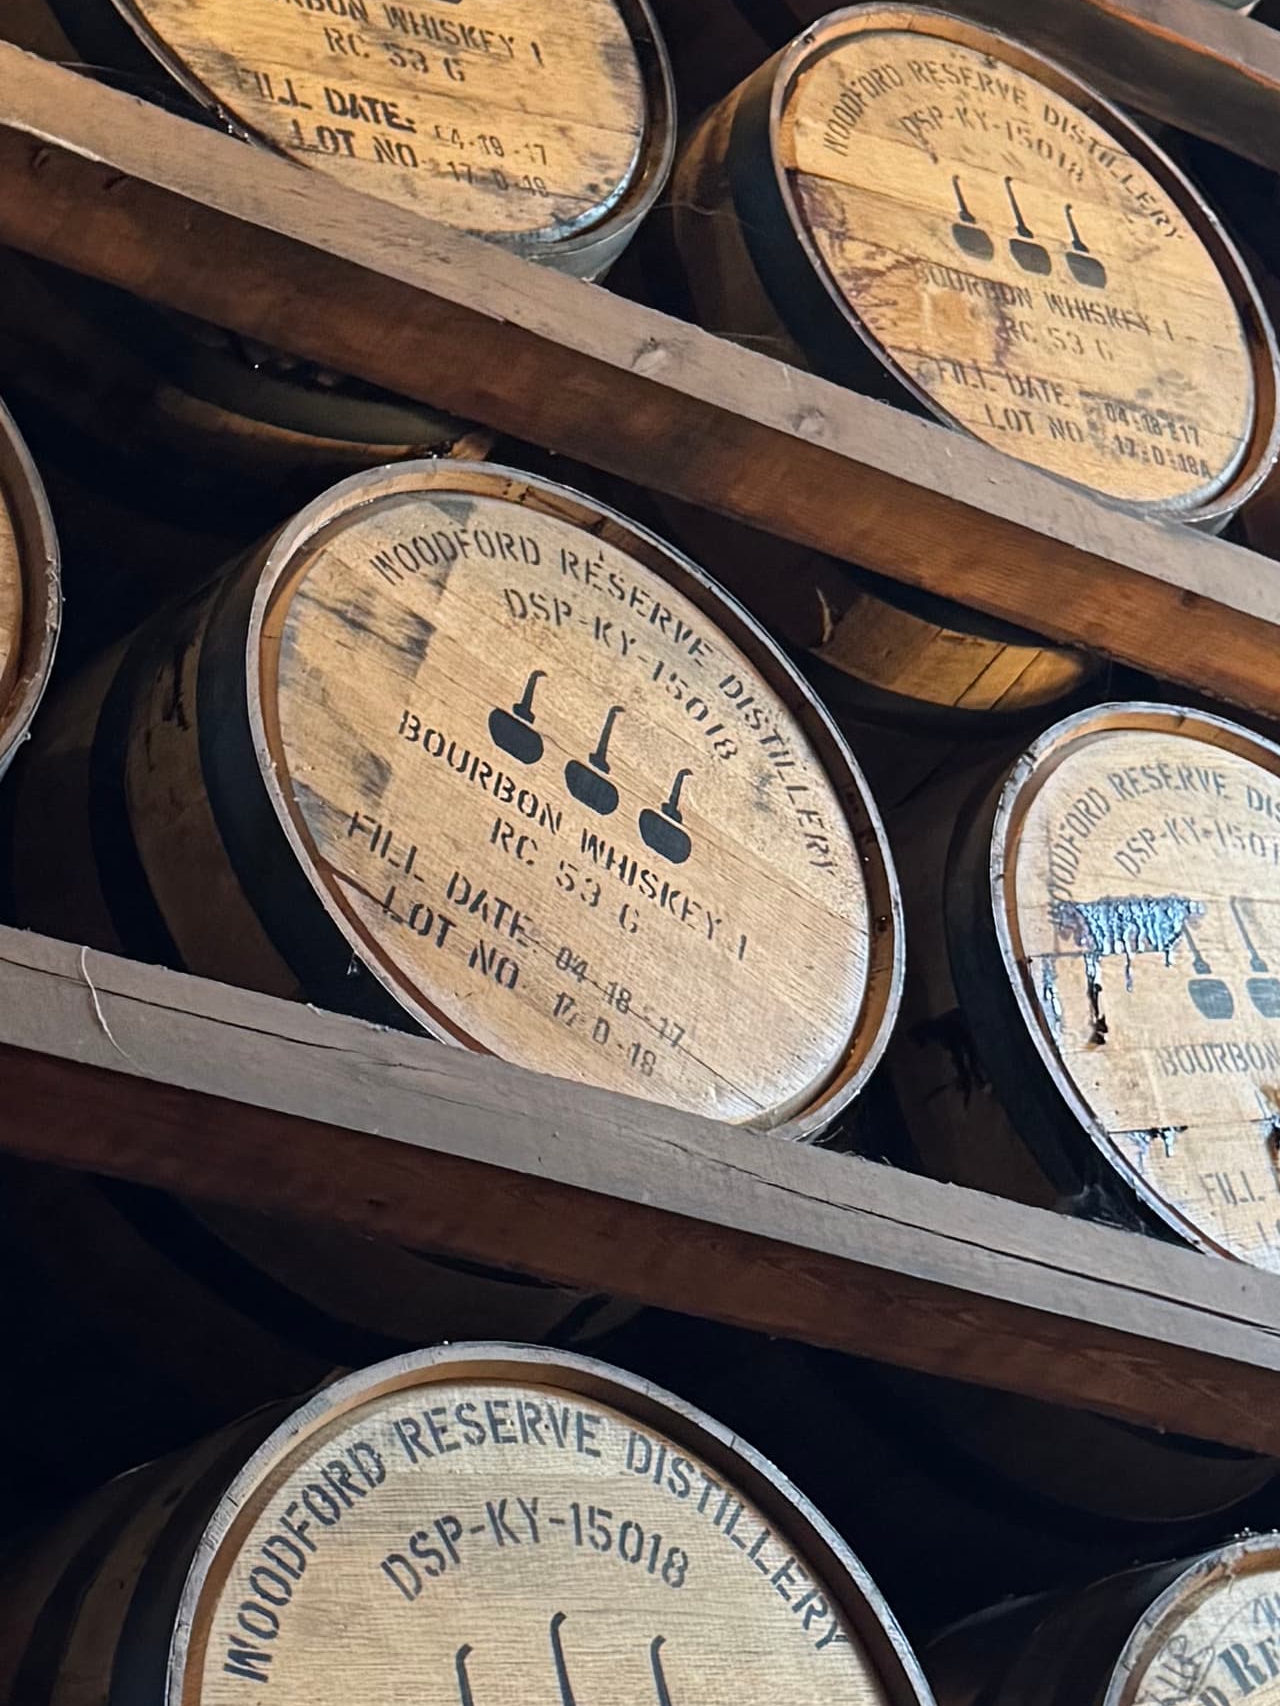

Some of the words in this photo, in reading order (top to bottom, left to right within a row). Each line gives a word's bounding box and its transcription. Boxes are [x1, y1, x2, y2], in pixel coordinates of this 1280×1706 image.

[382, 3, 515, 58] WHISKEY
[238, 68, 313, 111] FILL
[291, 119, 356, 159] LOT
[914, 60, 1027, 116] RESERVE
[1042, 103, 1185, 243] DISTILLERY
[1044, 292, 1153, 335] WHISKEY
[984, 403, 1036, 435] LOT
[369, 530, 541, 588] WOODFORD
[559, 547, 715, 670] RESERVE
[719, 672, 839, 879] DISTILLERY
[503, 587, 741, 761] DSP-KY-15018
[1107, 764, 1229, 803] RESERVE
[347, 810, 425, 884] FILL
[397, 709, 564, 835] BOURBON
[580, 827, 724, 941] WHISKEY
[738, 934, 748, 961] 1
[490, 816, 540, 866] RC
[556, 861, 602, 908] 53
[383, 885, 456, 949] LOT
[469, 939, 523, 991] NO
[1200, 1171, 1266, 1206] FILL
[223, 1441, 387, 1685] WOODFORD
[393, 1401, 602, 1467] RESERVE
[625, 1431, 850, 1654] DISTILLERY
[381, 1496, 689, 1601] DSP-KY-15018
